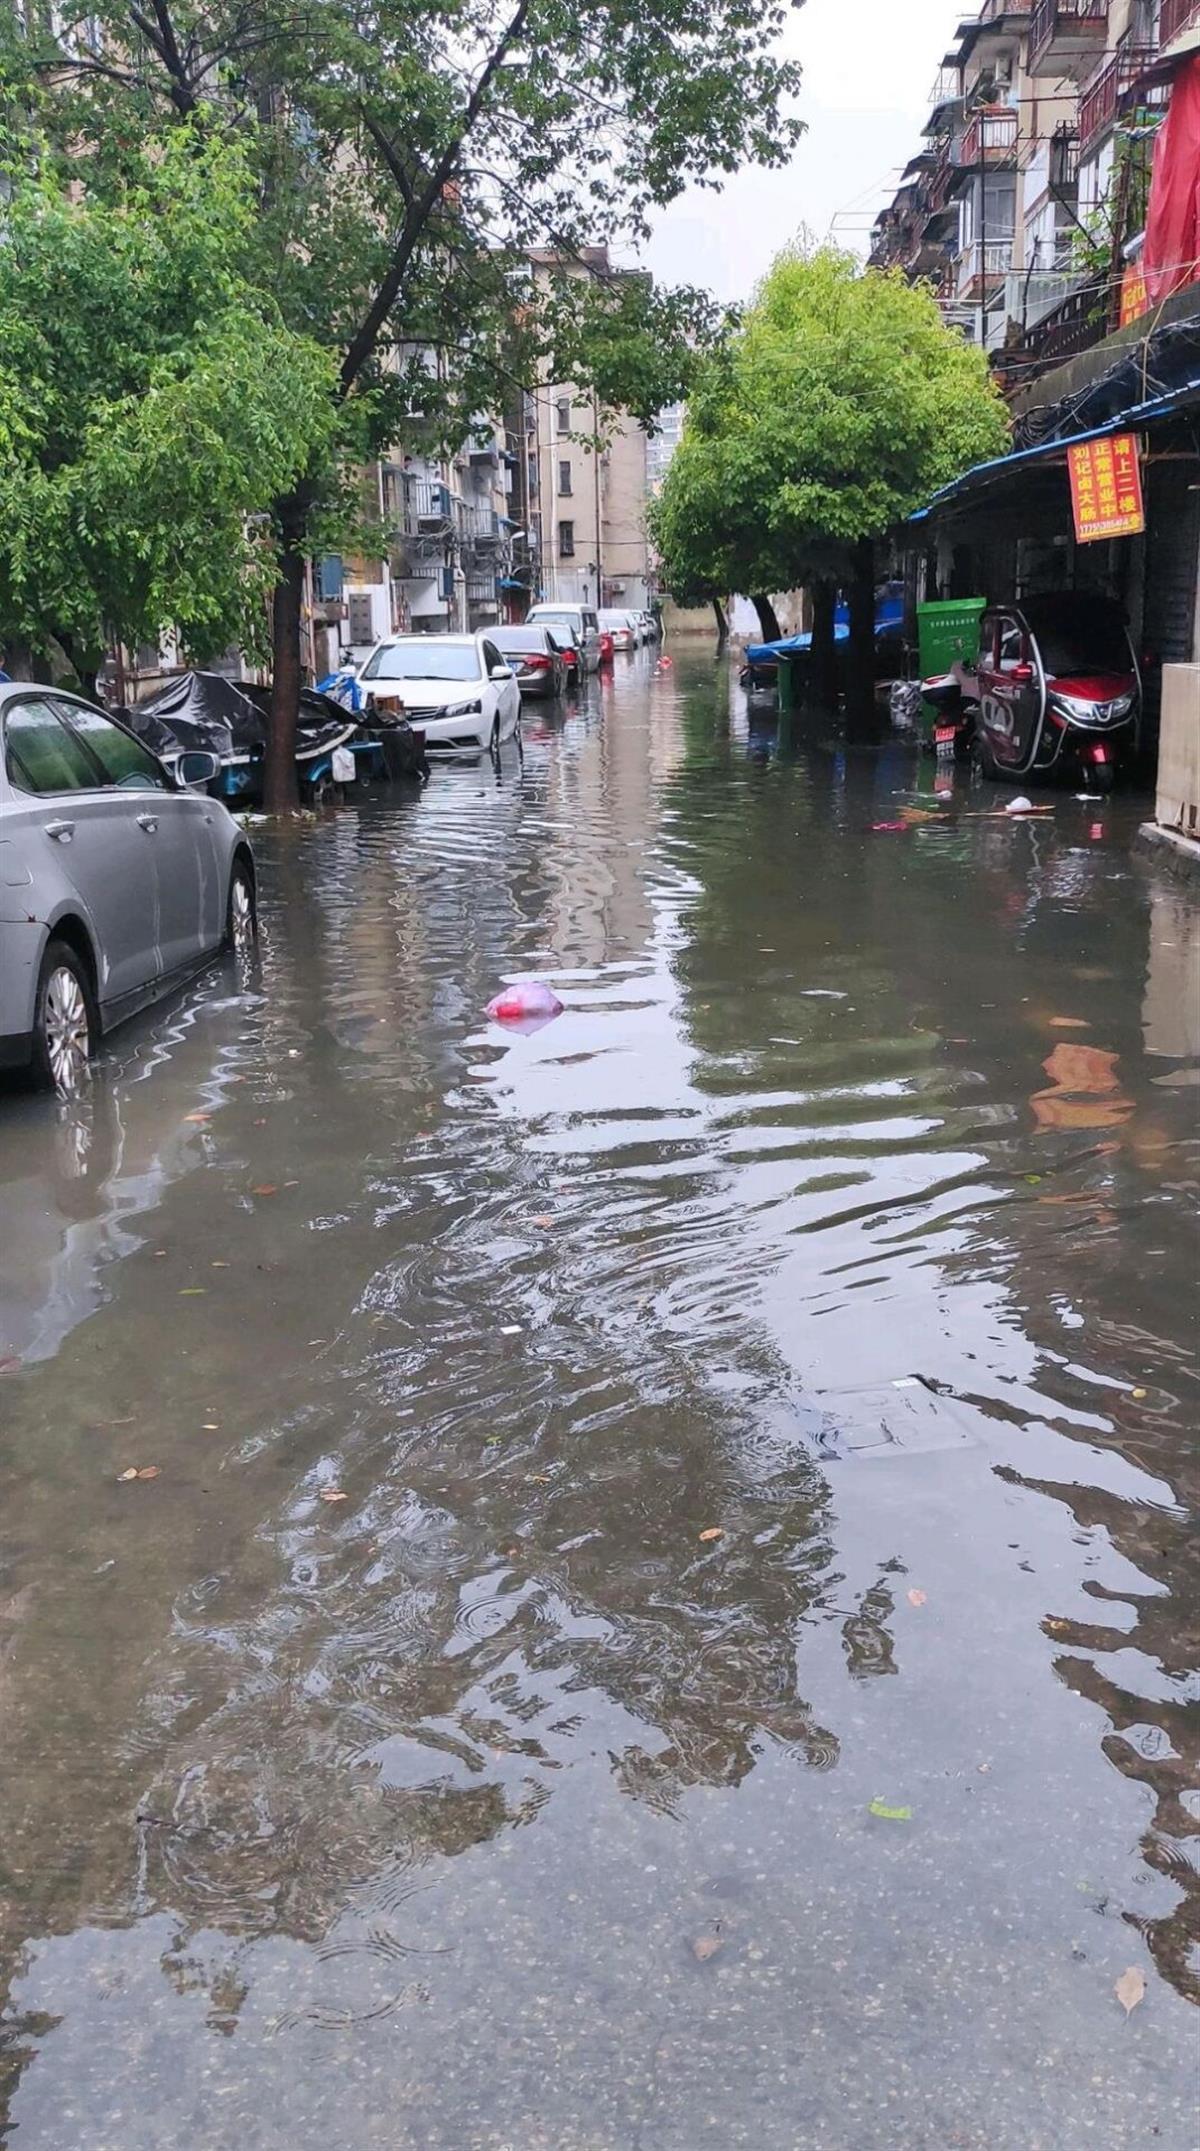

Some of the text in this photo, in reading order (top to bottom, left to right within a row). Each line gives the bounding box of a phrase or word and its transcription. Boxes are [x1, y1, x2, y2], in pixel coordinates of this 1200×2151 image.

[1095, 443, 1117, 517] 正常营业中
[1113, 439, 1137, 512] 请上二楼
